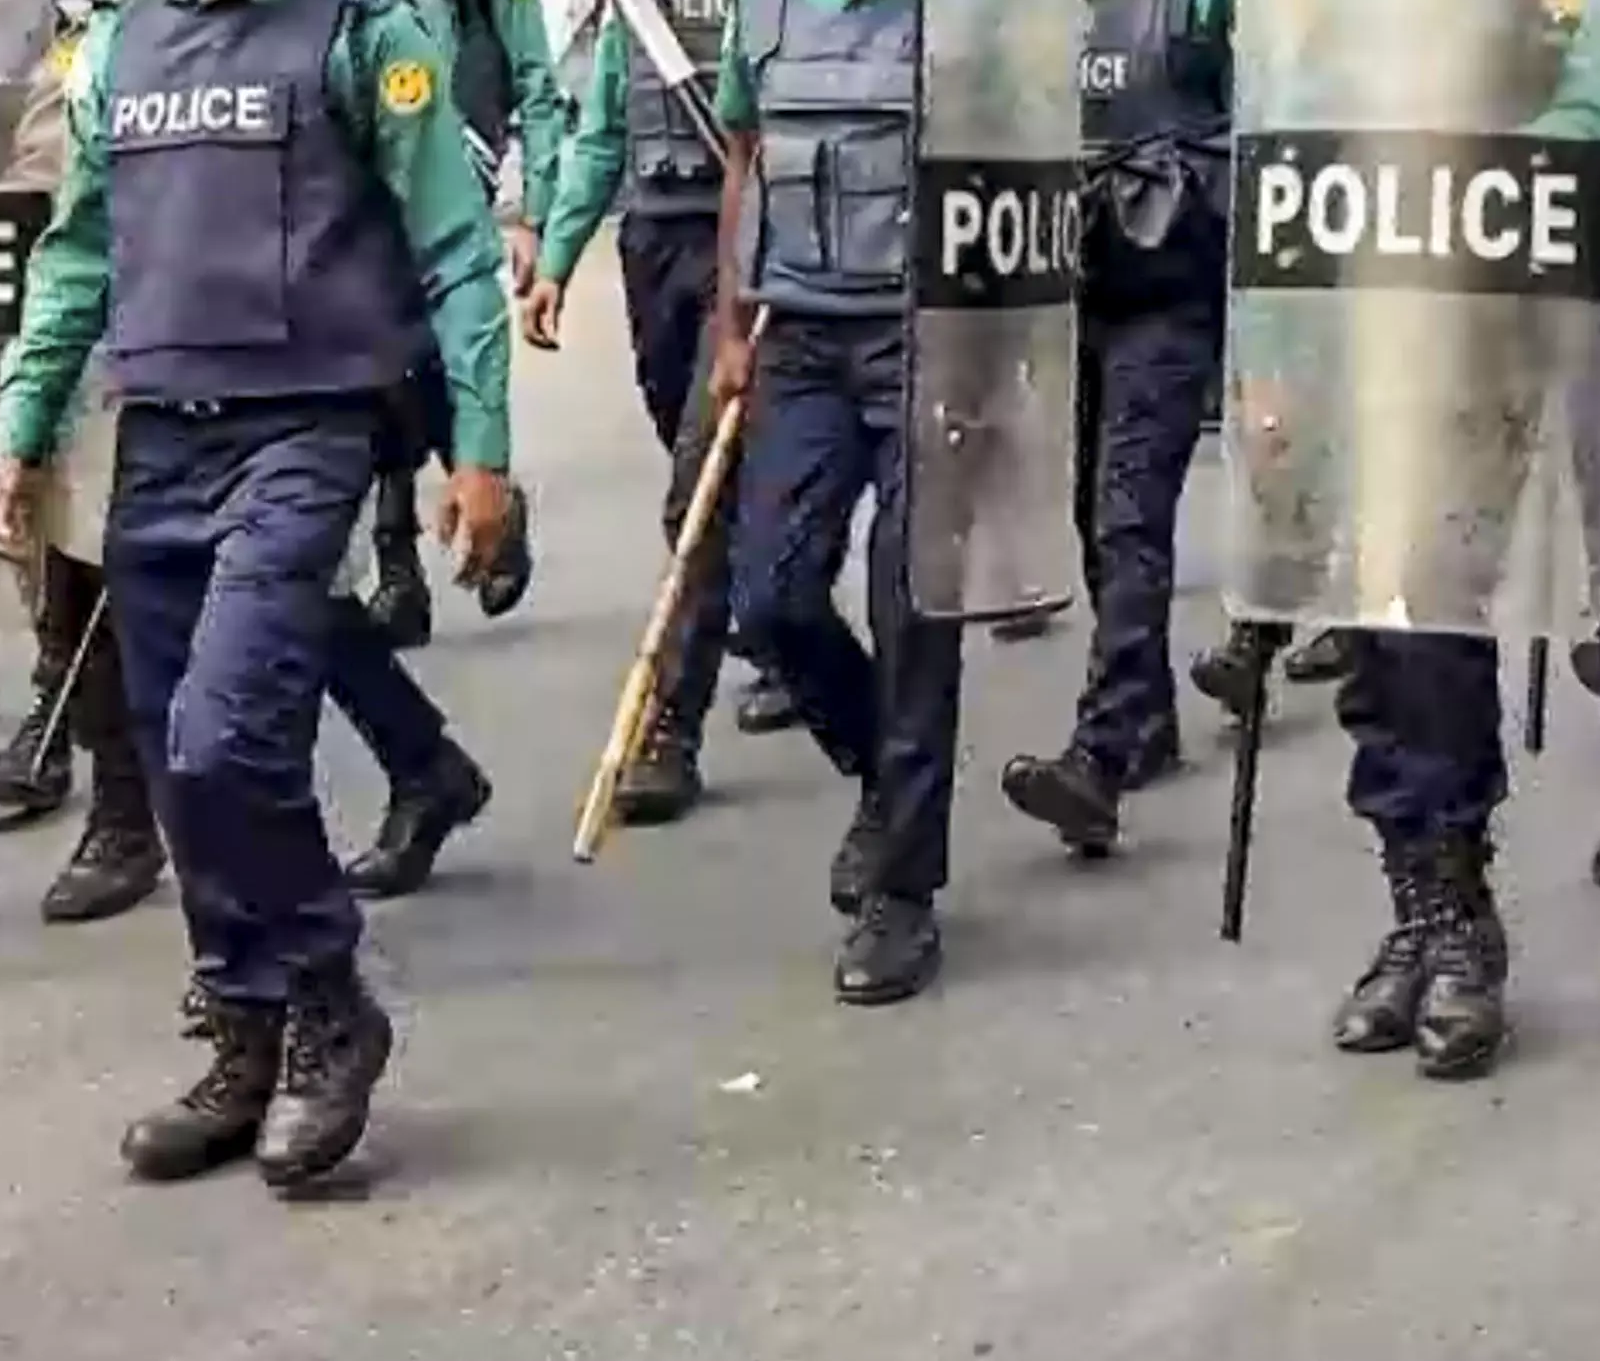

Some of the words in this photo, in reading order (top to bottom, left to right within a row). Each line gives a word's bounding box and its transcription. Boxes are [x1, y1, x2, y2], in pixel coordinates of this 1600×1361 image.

[113, 84, 268, 137] POLICE
[942, 189, 1084, 275] POLIC
[1256, 163, 1579, 266] POLICE
